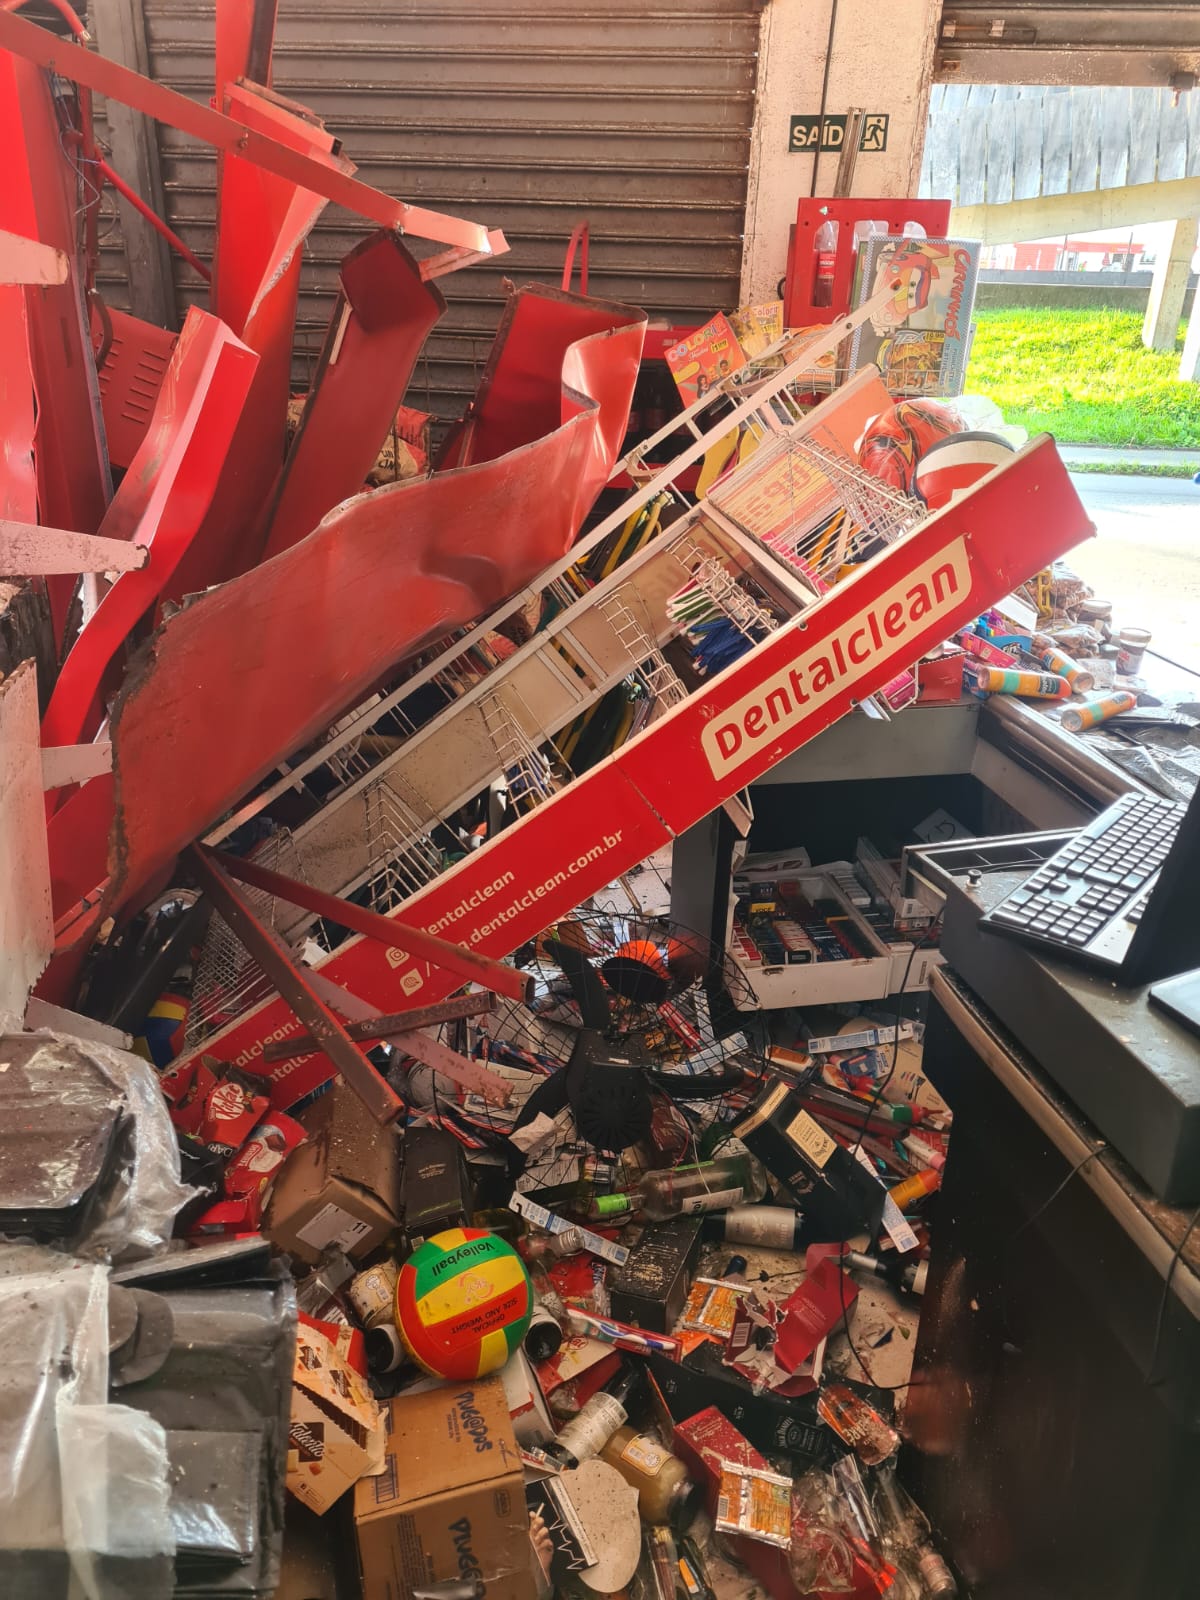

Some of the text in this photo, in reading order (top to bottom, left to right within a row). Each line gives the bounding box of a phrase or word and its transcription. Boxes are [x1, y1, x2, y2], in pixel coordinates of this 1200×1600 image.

[715, 563, 958, 760] Dentalclean
[352, 1222, 367, 1235] 11
[432, 1242, 496, 1277] Volleyball
